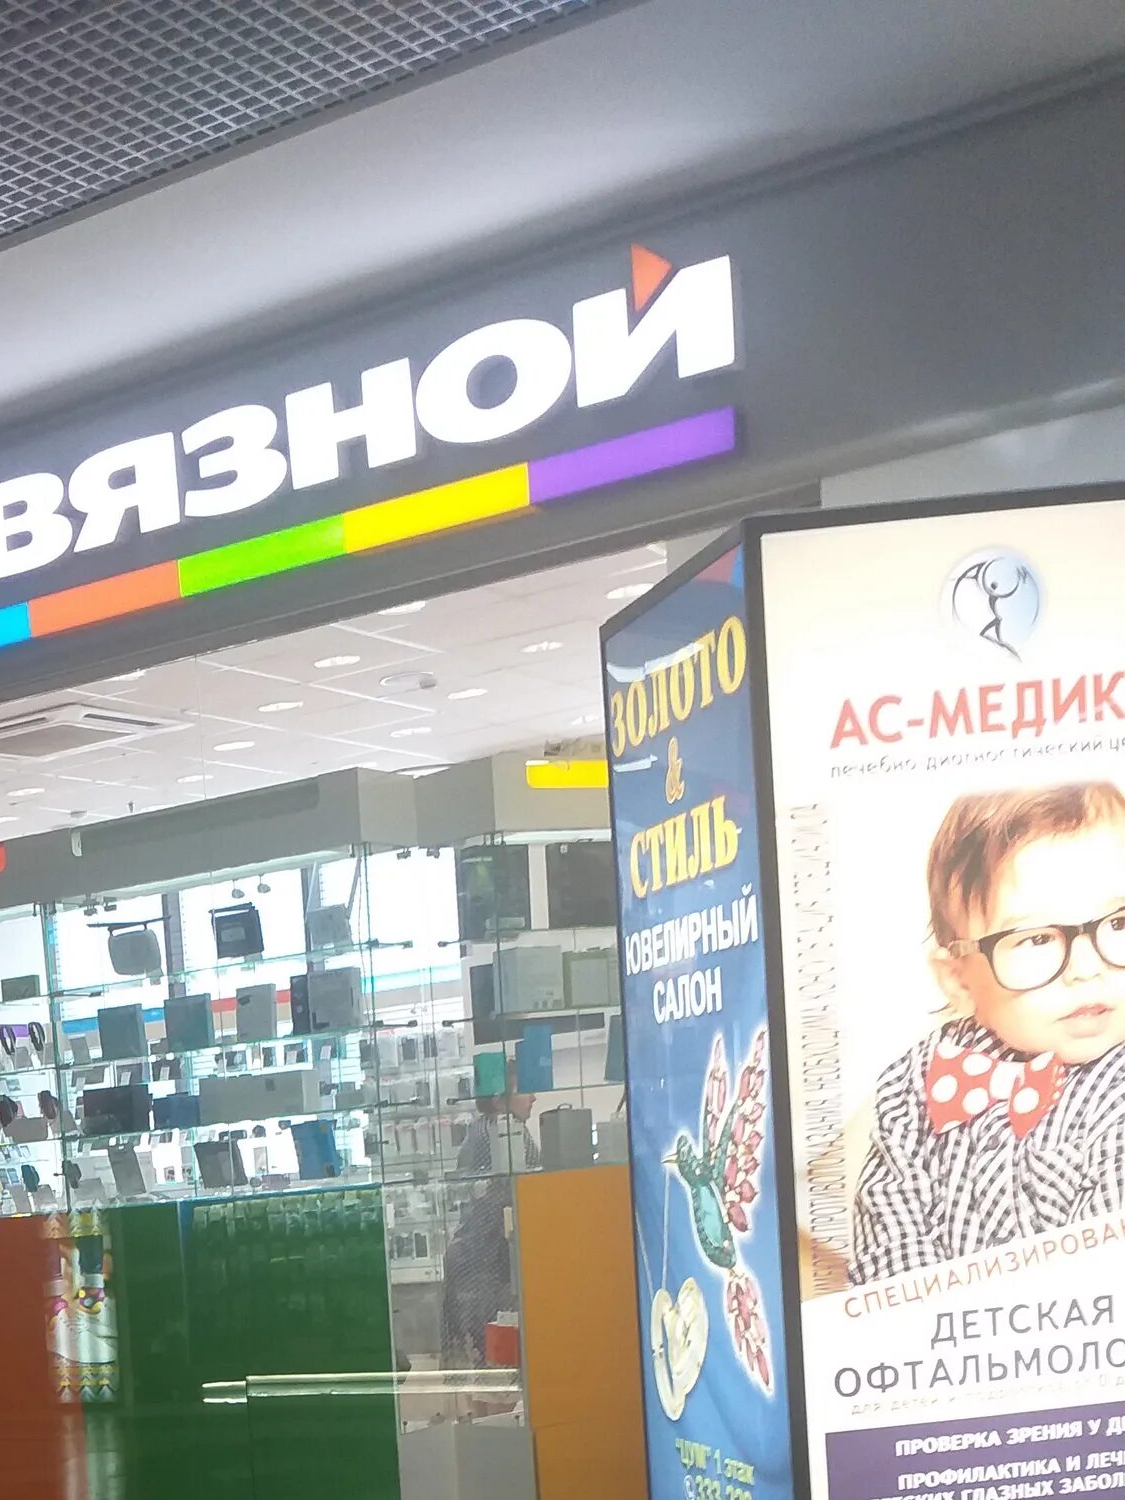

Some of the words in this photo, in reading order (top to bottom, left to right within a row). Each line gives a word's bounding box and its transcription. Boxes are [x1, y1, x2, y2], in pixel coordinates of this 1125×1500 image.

[610, 615, 747, 758] ЗОЛОТО
[665, 736, 685, 804] &
[630, 795, 739, 898] СТИЛЬ
[625, 882, 759, 976] ЮВЕЛИРНЫЙ
[653, 966, 723, 1025] САЛОН
[931, 1294, 1114, 1350] ДЕТСКАЯ
[834, 1338, 1125, 1398] ОФТАЛЬМОЛО
[714, 1449, 722, 1474] 1
[895, 1430, 1002, 1457] ПРОВЕРКА
[1006, 1419, 1083, 1445] ЗРЕНИЯ
[1087, 1418, 1102, 1436] У
[898, 1458, 1062, 1490] ПРОФИЛАКТИКА
[1065, 1454, 1081, 1471] И
[1059, 1472, 1125, 1495] ЗАБОЛ
